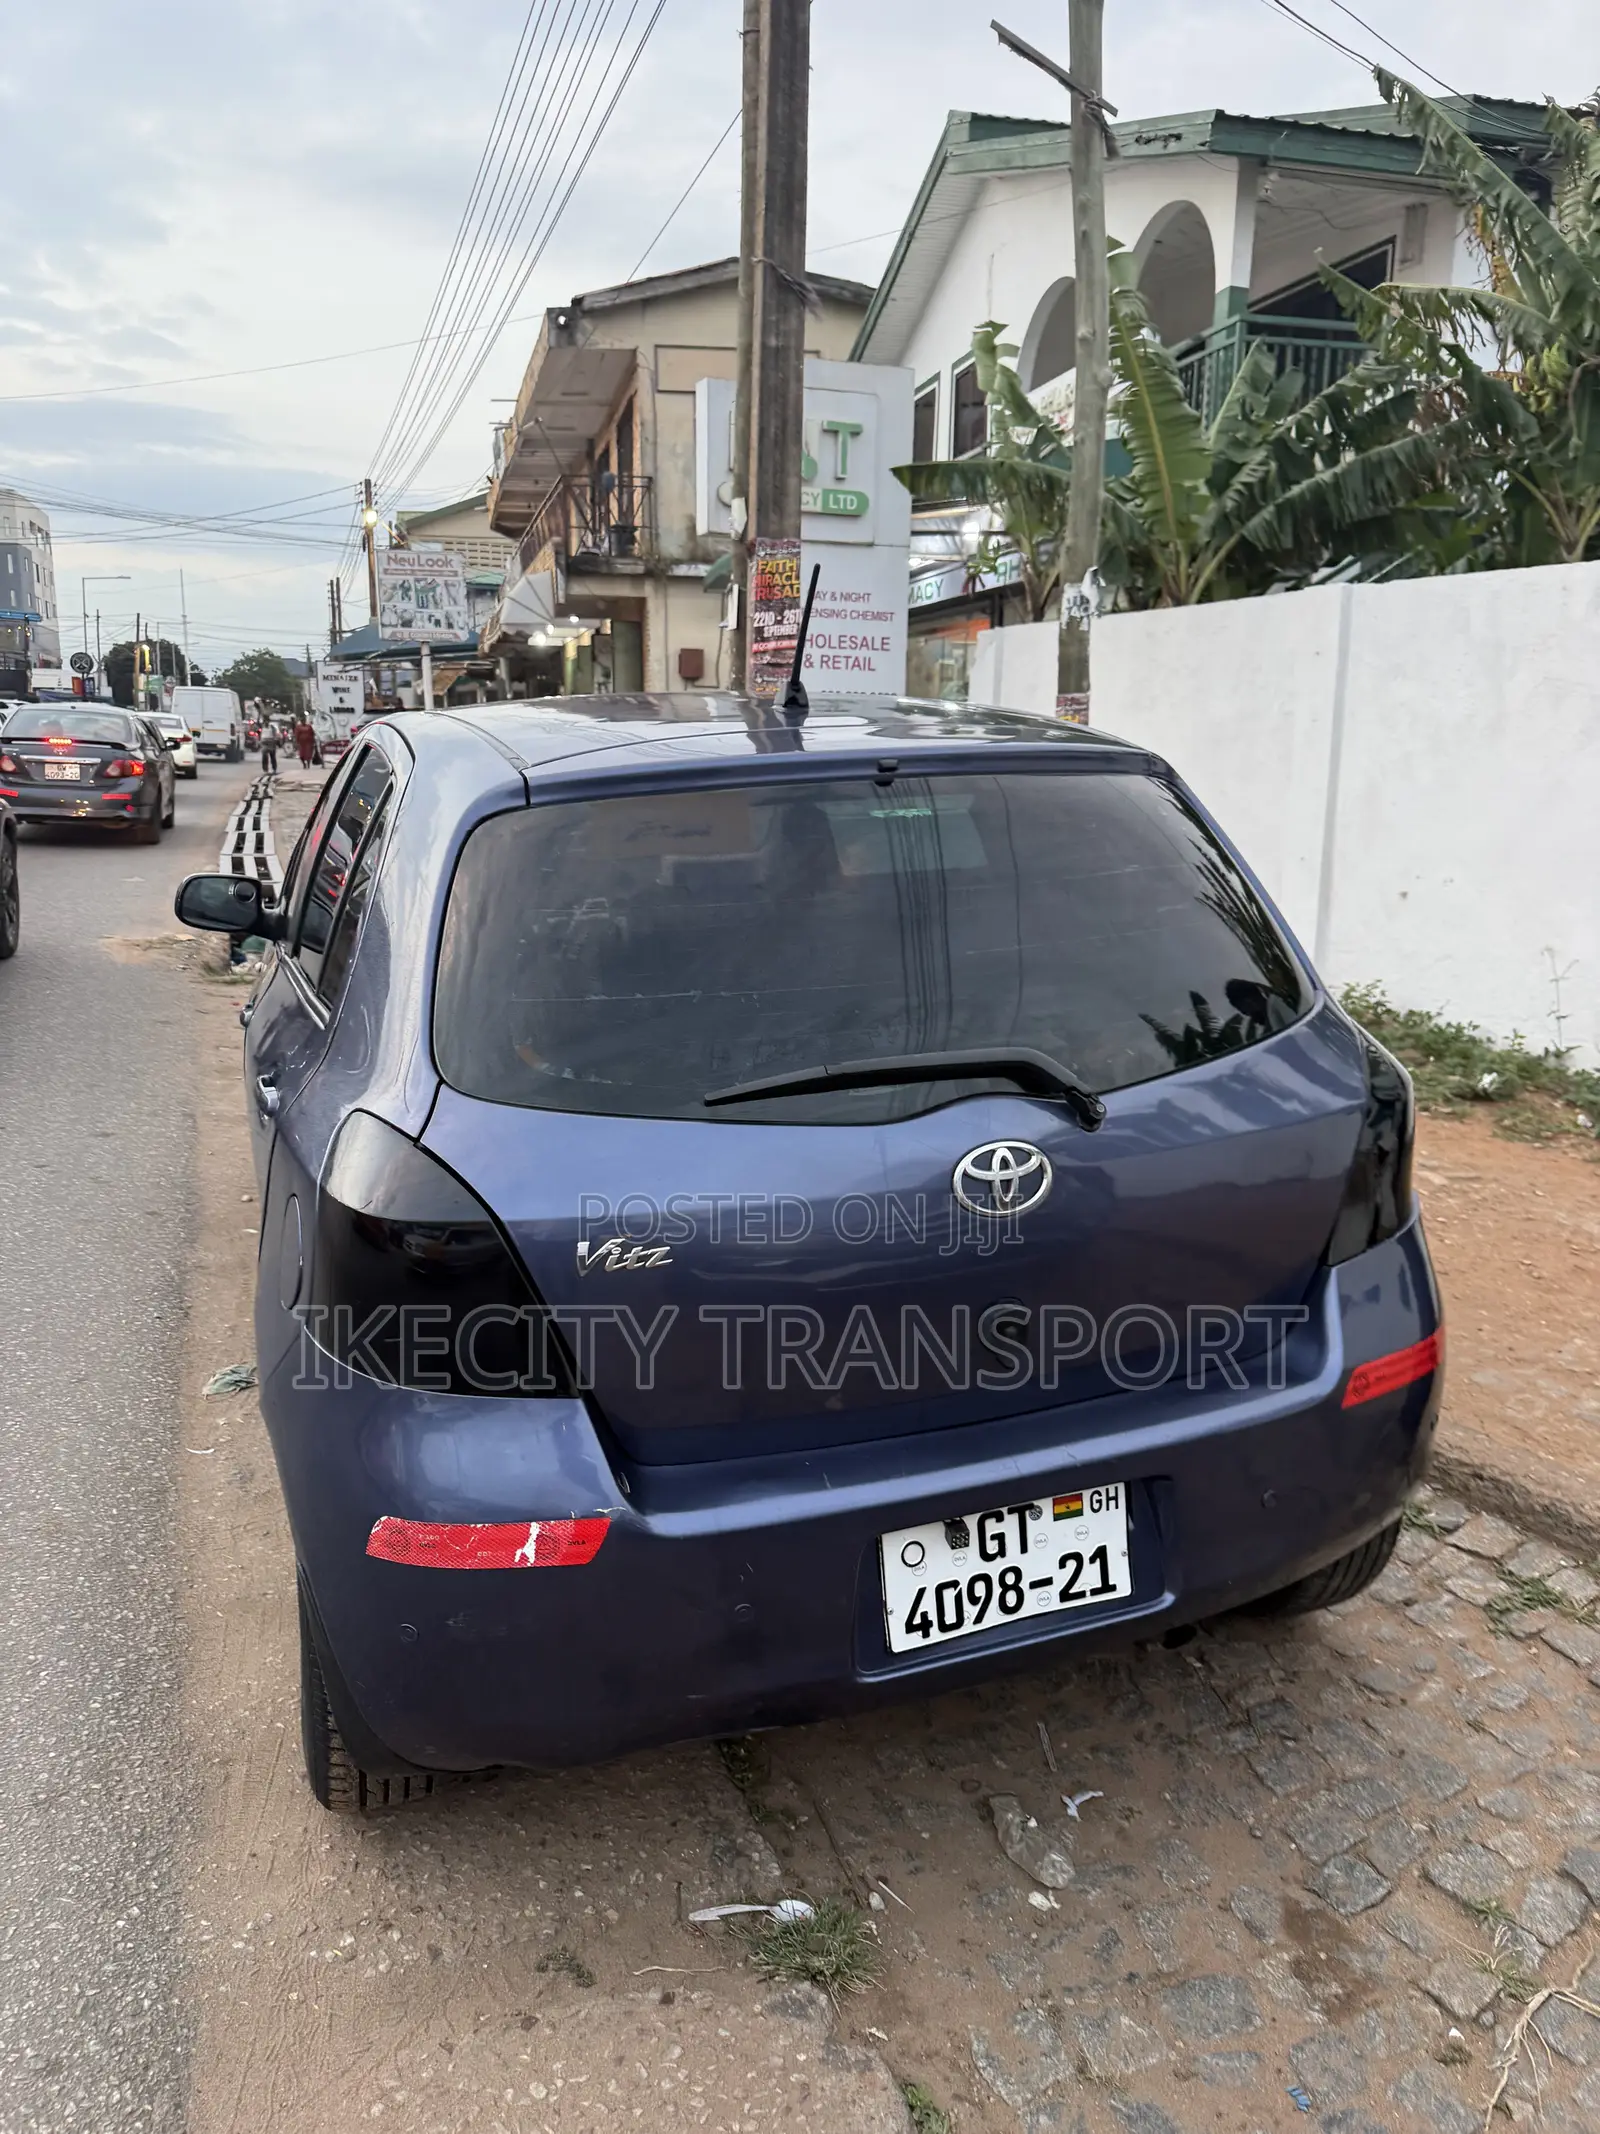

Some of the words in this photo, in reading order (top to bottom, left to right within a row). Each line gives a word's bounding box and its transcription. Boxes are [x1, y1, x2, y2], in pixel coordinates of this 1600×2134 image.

[828, 493, 858, 510] LTD
[757, 558, 798, 574] FAITH
[752, 571, 800, 587] MIRACL
[752, 584, 800, 601] CRUSAD
[814, 590, 828, 601] AY
[830, 591, 837, 602] &
[840, 592, 871, 603] NIGHT
[908, 578, 944, 605] MACY
[782, 610, 802, 625] 26T
[810, 608, 848, 620] ENSING
[849, 610, 895, 622] CHEMIST
[804, 633, 891, 652] HOLESALE
[803, 653, 814, 669] &
[820, 654, 876, 672] RETAIL
[577, 1238, 673, 1277] Vitz
[976, 1502, 1035, 1563] GT
[1089, 1486, 1119, 1514] GH
[904, 1544, 1117, 1640] 4098-21
